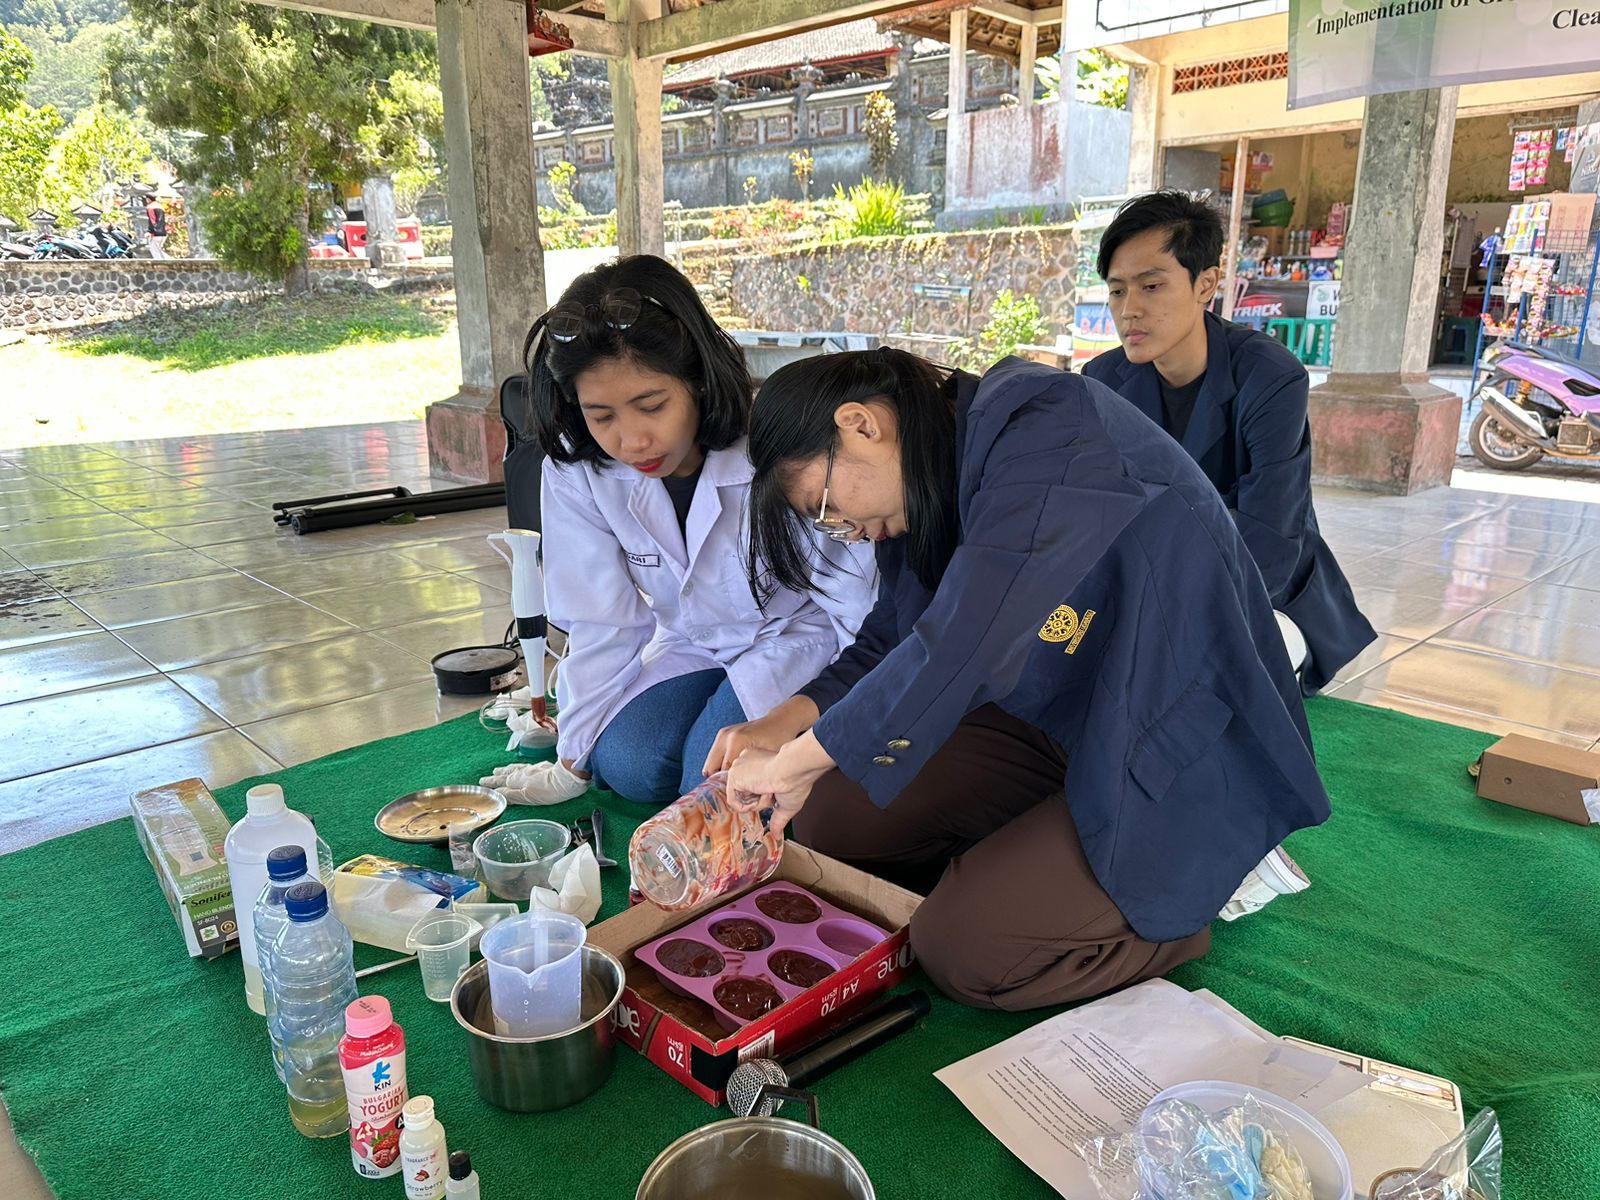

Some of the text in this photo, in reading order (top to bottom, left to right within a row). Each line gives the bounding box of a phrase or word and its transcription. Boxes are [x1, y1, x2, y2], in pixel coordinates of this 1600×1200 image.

[1316, 0, 1443, 34] Implementation
[191, 891, 232, 906] Sonifer
[842, 979, 859, 999] A4
[821, 998, 837, 1017] 70
[668, 1046, 685, 1068] 70
[363, 1086, 402, 1105] BULGARIAN
[374, 1080, 392, 1092] KIN
[360, 1090, 405, 1117] YOGURT
